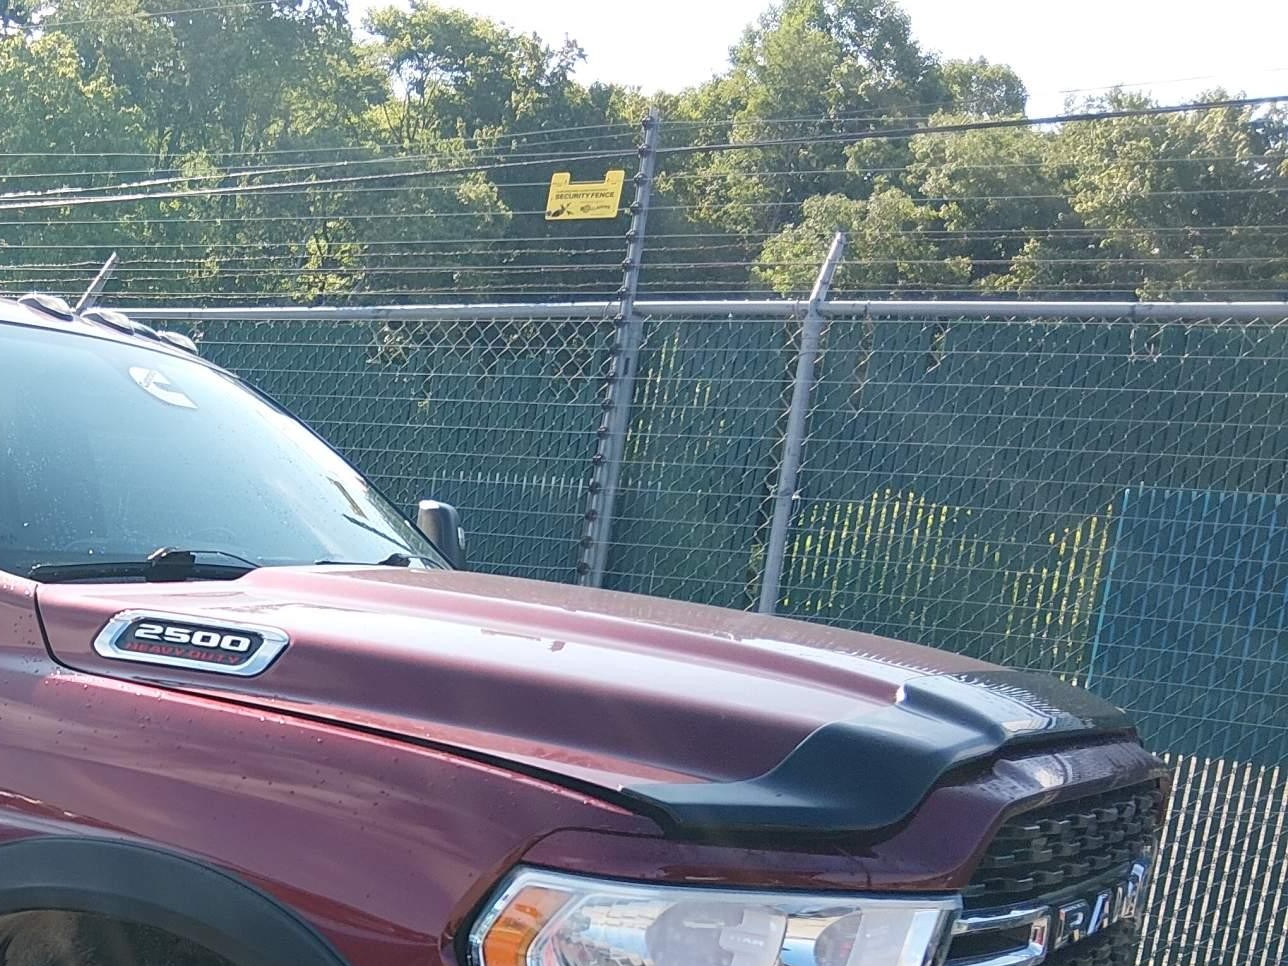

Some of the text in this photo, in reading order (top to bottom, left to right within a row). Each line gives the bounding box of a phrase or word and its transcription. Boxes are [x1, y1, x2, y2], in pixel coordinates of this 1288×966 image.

[555, 192, 590, 200] SECURITY
[135, 623, 250, 652] 2500
[125, 641, 241, 664] HEAVY DUTY
[1054, 862, 1146, 949] RAM
